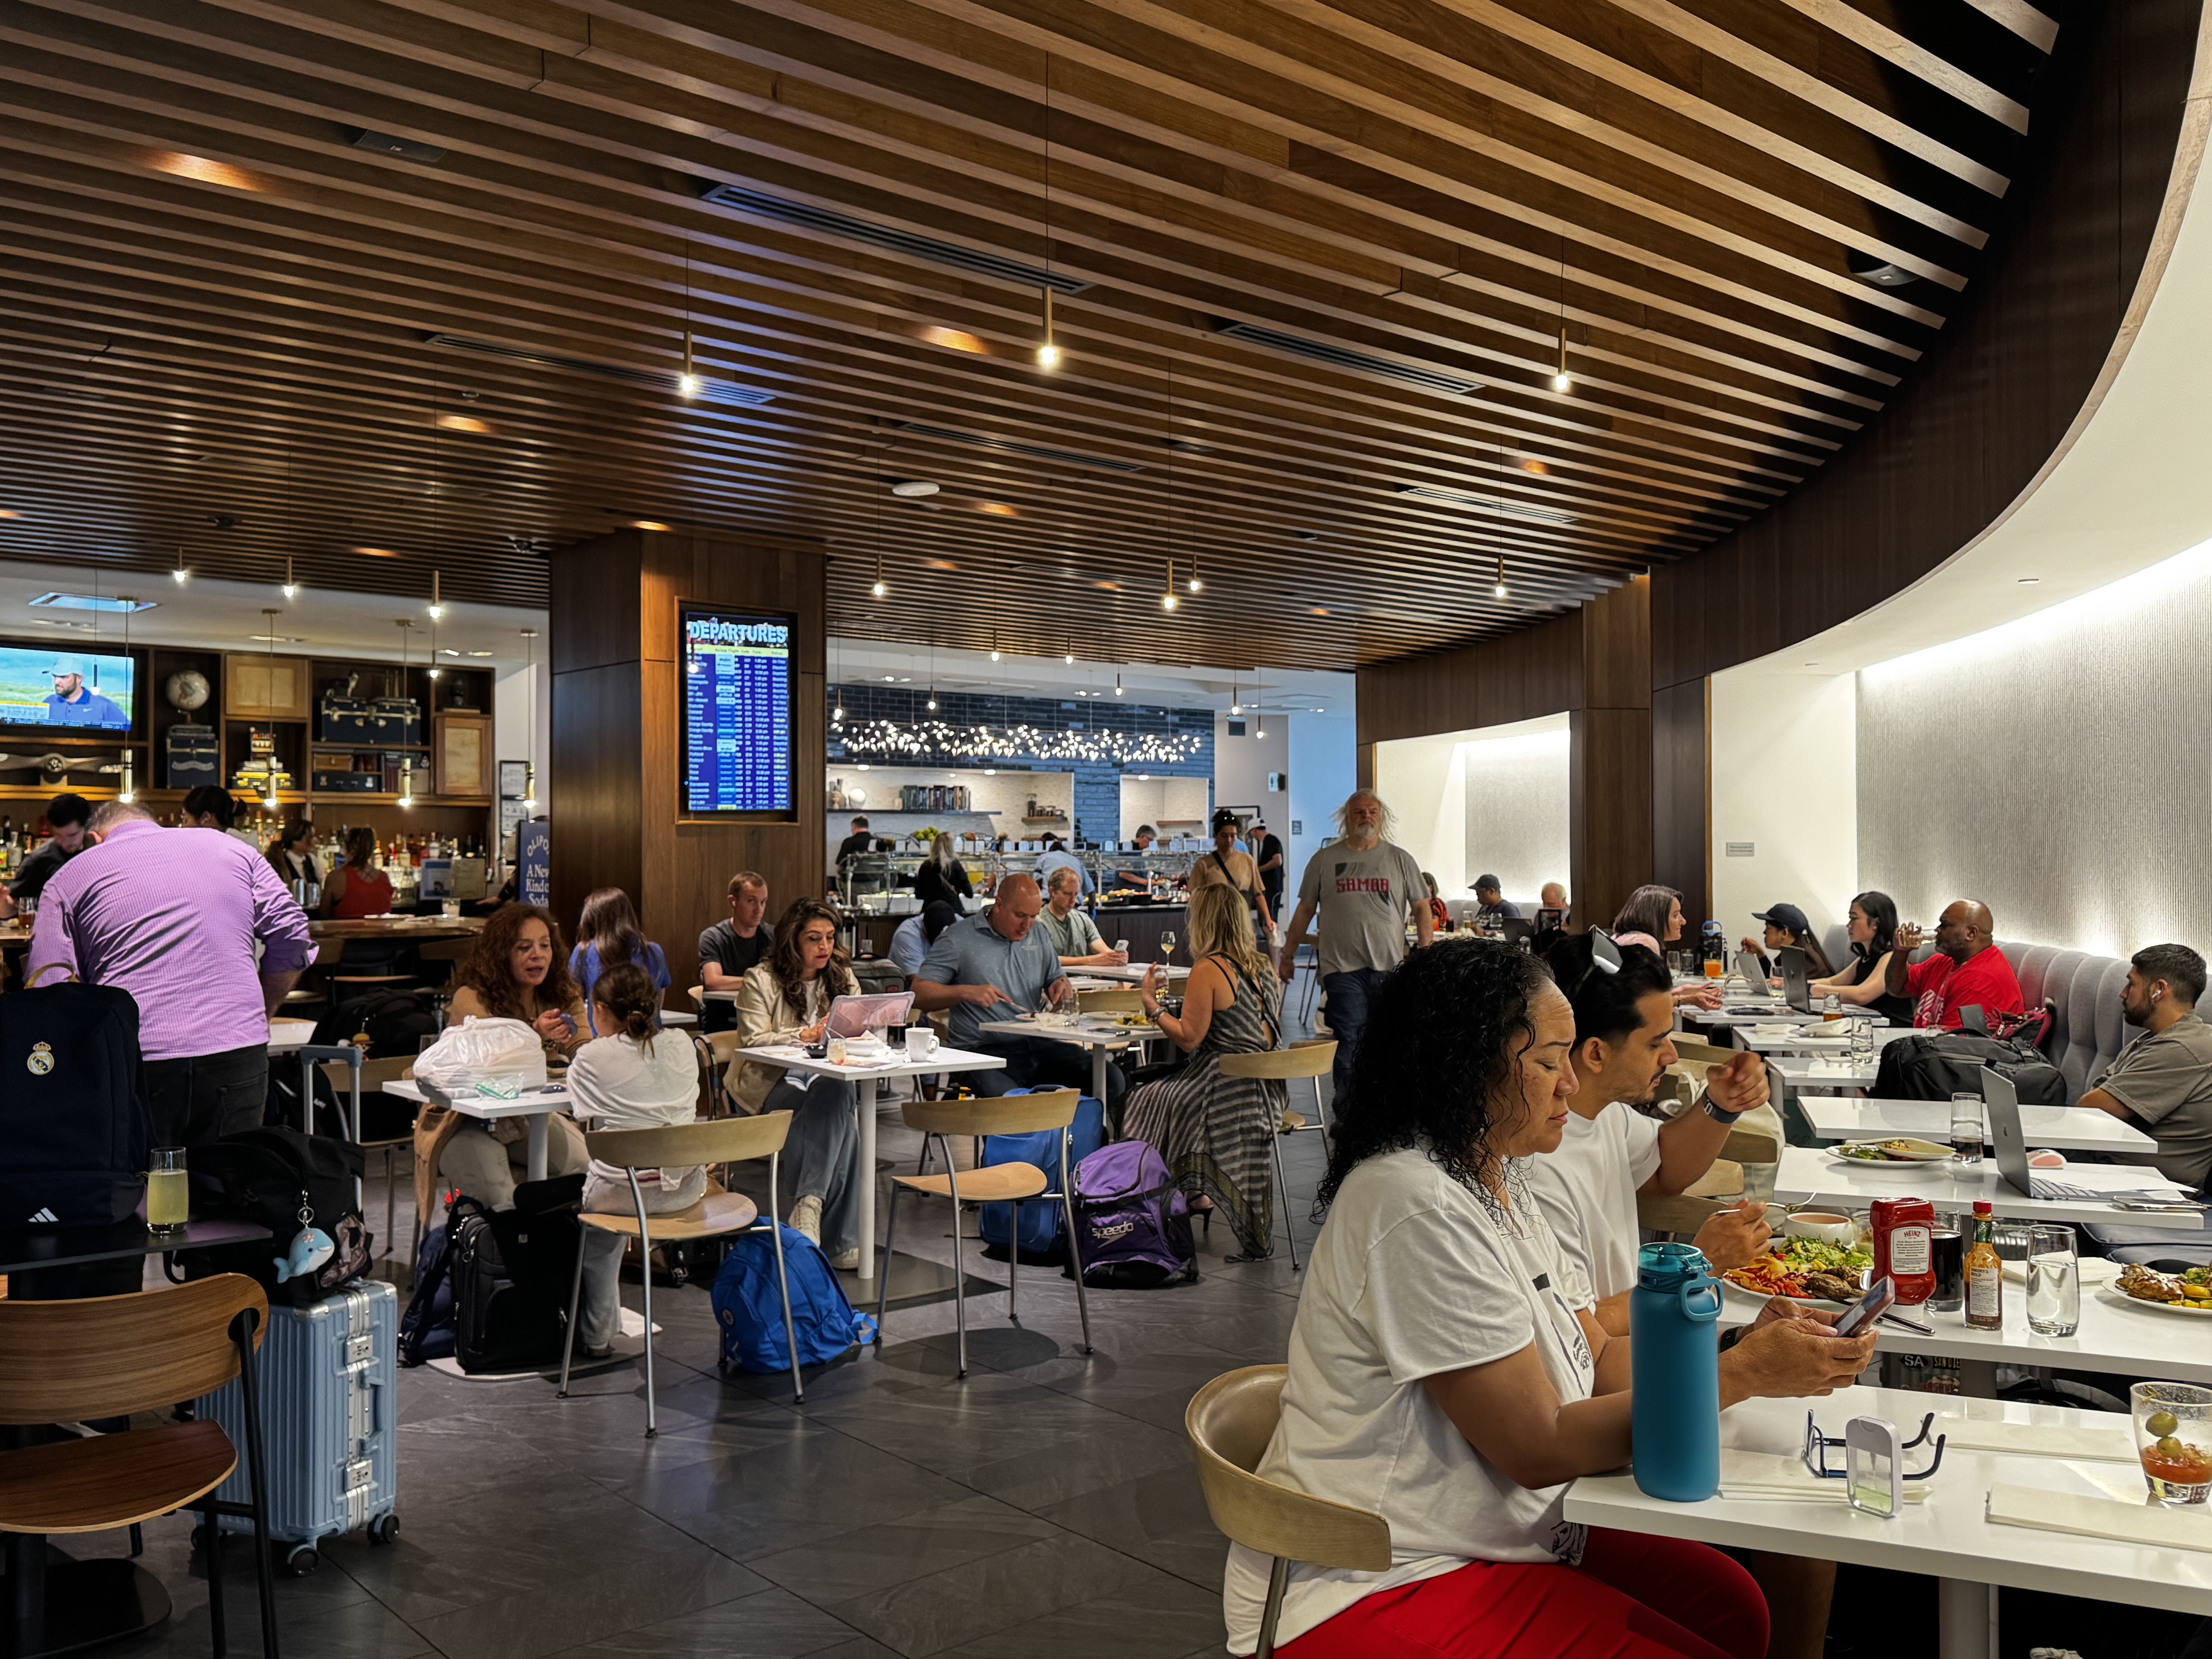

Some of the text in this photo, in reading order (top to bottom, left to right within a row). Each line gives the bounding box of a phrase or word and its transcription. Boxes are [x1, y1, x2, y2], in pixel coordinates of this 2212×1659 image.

[690, 622, 787, 643] DEPARTURES
[527, 835, 549, 857] OLIPO
[527, 864, 533, 877] A
[526, 879, 544, 892] Kind
[1092, 1221, 1134, 1238] speedo
[1949, 1358, 1960, 1369] DIE
